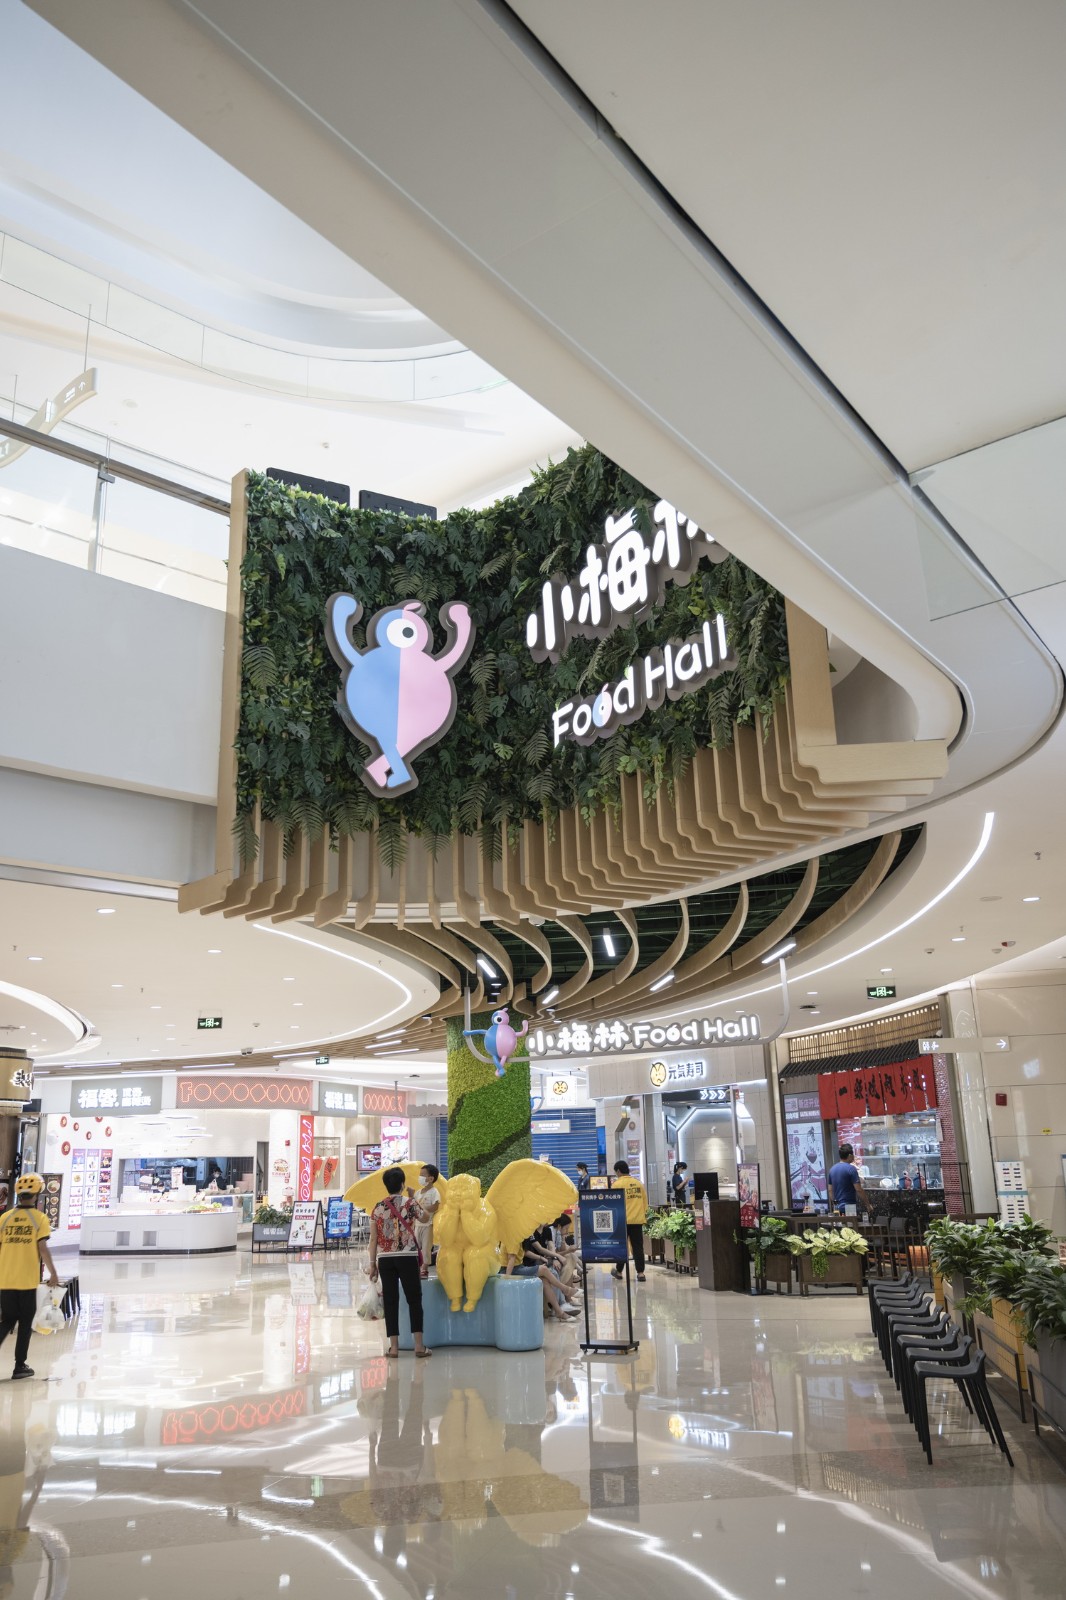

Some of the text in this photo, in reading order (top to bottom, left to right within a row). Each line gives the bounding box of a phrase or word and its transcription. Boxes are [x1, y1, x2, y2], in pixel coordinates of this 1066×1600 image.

[552, 613, 728, 748] Food Hall
[528, 1020, 629, 1052] 小梅林
[633, 1016, 758, 1047] Food Hall
